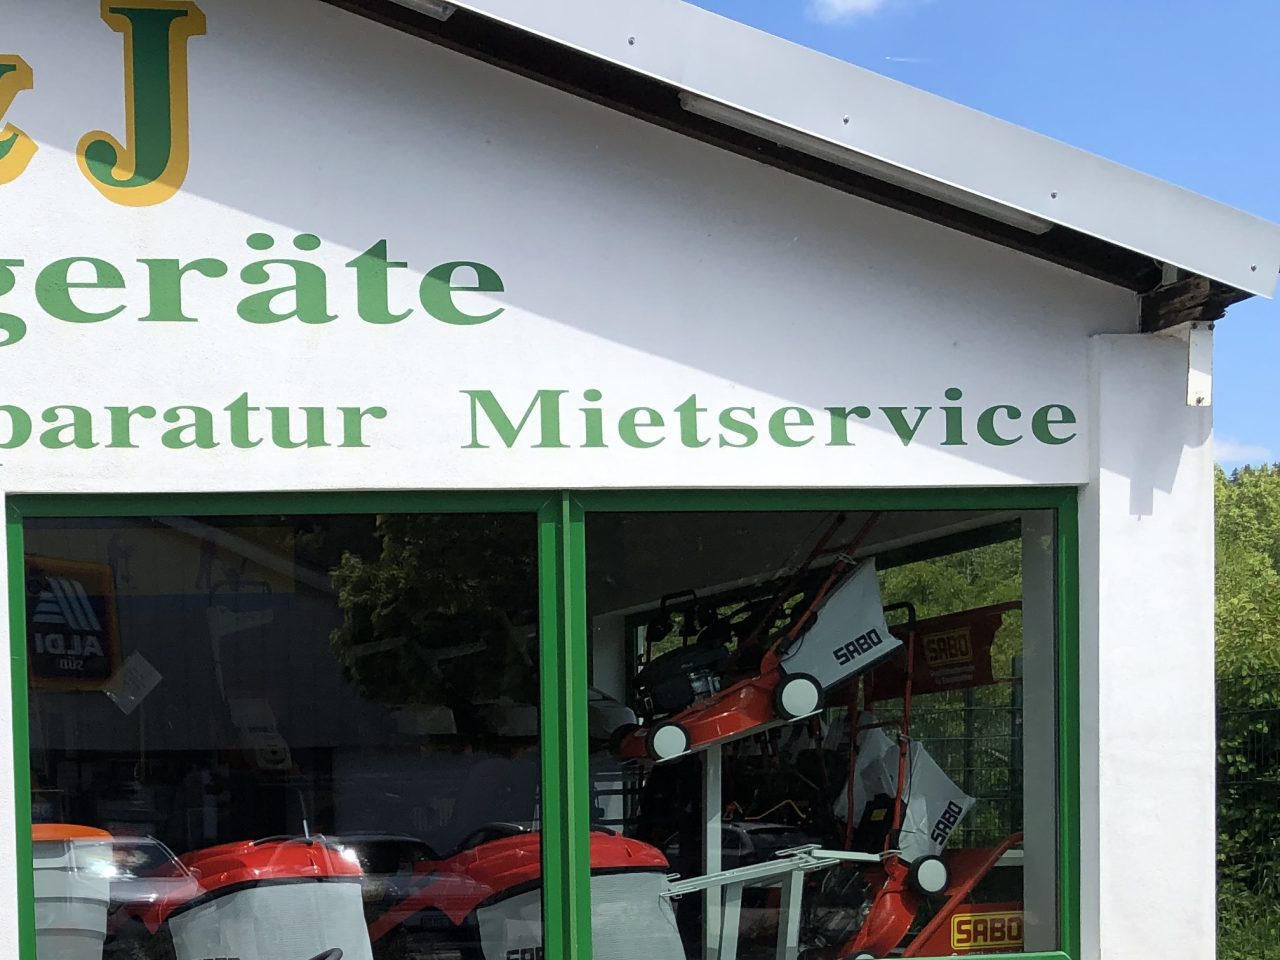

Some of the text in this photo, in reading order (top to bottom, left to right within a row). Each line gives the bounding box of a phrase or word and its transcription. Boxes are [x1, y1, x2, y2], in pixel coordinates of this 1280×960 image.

[76, 0, 206, 207] J
[462, 388, 1076, 450] Mietservice
[833, 629, 882, 666] SABO
[927, 633, 969, 661] SABO
[931, 800, 963, 846] SABO
[956, 916, 1024, 944] SABO
